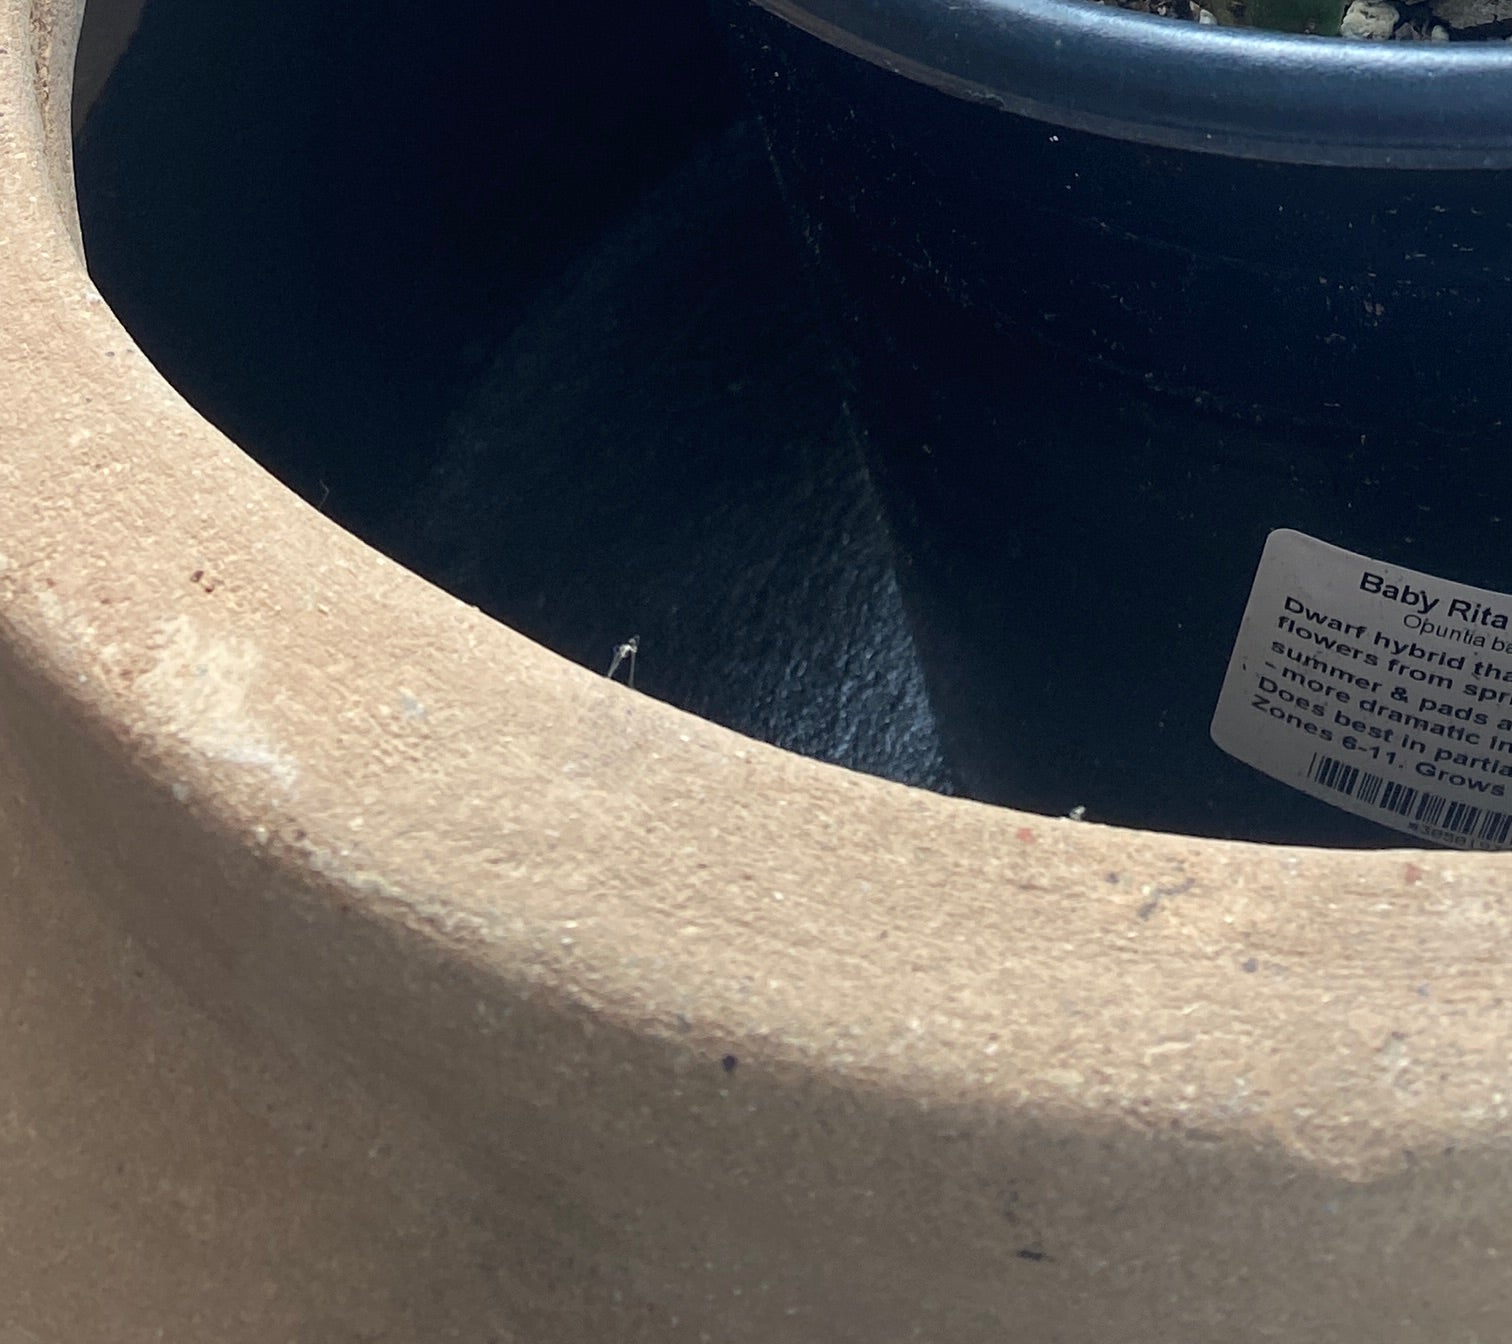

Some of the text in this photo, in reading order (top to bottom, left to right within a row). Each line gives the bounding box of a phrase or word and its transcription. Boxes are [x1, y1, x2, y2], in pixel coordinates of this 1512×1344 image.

[1284, 596, 1367, 639] Dwarf
[1374, 631, 1466, 671] hybrid
[1359, 572, 1440, 615] Baby
[1447, 598, 1509, 630] Rita
[1403, 614, 1486, 647] Opuntia
[1271, 641, 1383, 692] summer
[1390, 686, 1409, 704] &
[1418, 697, 1489, 725] pads
[1278, 615, 1379, 666] flowers
[1387, 658, 1453, 689] from
[1258, 675, 1326, 717] Does
[1334, 710, 1394, 743] best
[1401, 734, 1426, 754] in
[1281, 667, 1350, 703] more
[1359, 699, 1480, 745] dramatic
[1251, 694, 1334, 742] Zones
[1415, 762, 1505, 797] Grows
